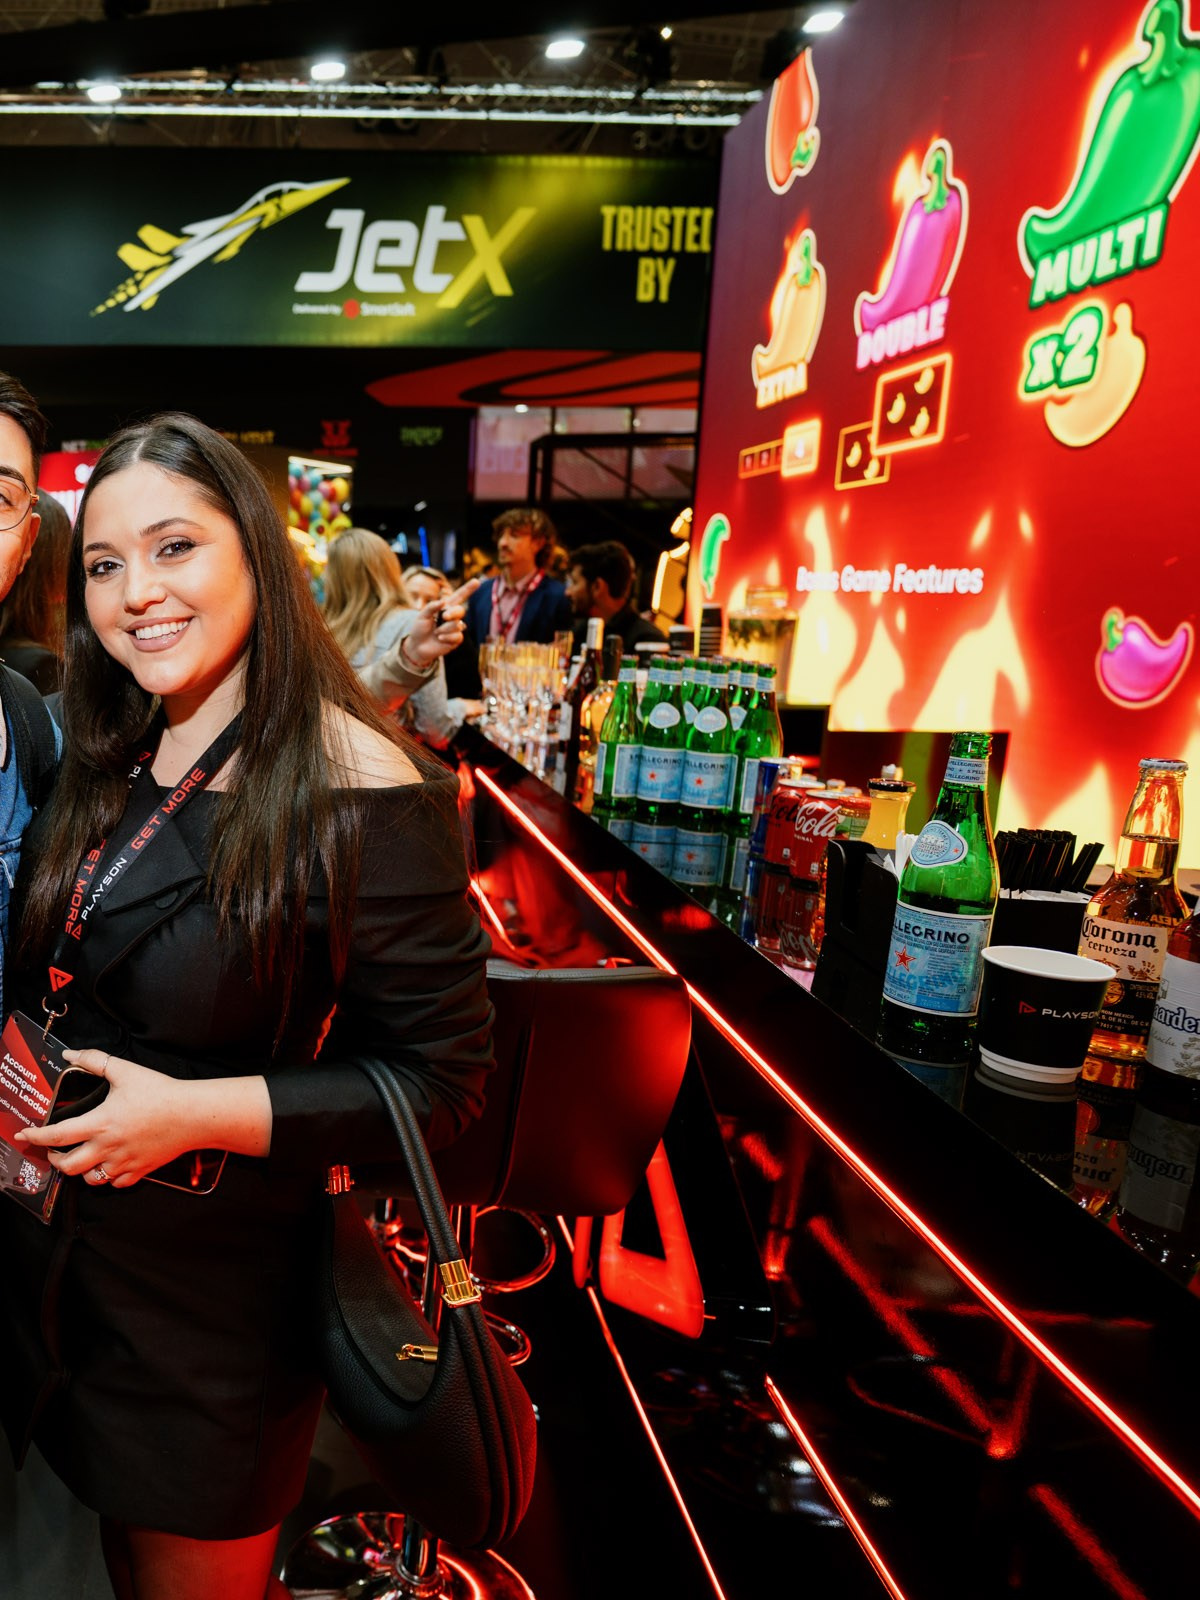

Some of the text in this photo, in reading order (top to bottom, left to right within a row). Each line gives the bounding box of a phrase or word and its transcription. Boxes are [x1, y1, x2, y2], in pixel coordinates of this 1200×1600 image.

[294, 205, 537, 308] JetX
[636, 256, 676, 303] BY
[1030, 205, 1167, 308] MULTI
[856, 296, 949, 369] DOUBLE
[841, 565, 891, 592] Game
[893, 563, 984, 594] Features
[131, 767, 206, 850] GET MORE
[65, 879, 87, 935] MORE
[81, 857, 128, 921] PLAYSON
[1081, 916, 1156, 949] Corona
[1087, 936, 1137, 959] cerveza
[0, 1061, 52, 1106] Managemen
[3, 1052, 38, 1084] Account
[10, 1104, 30, 1125] Mihaela
[18, 1089, 48, 1117] Leader
